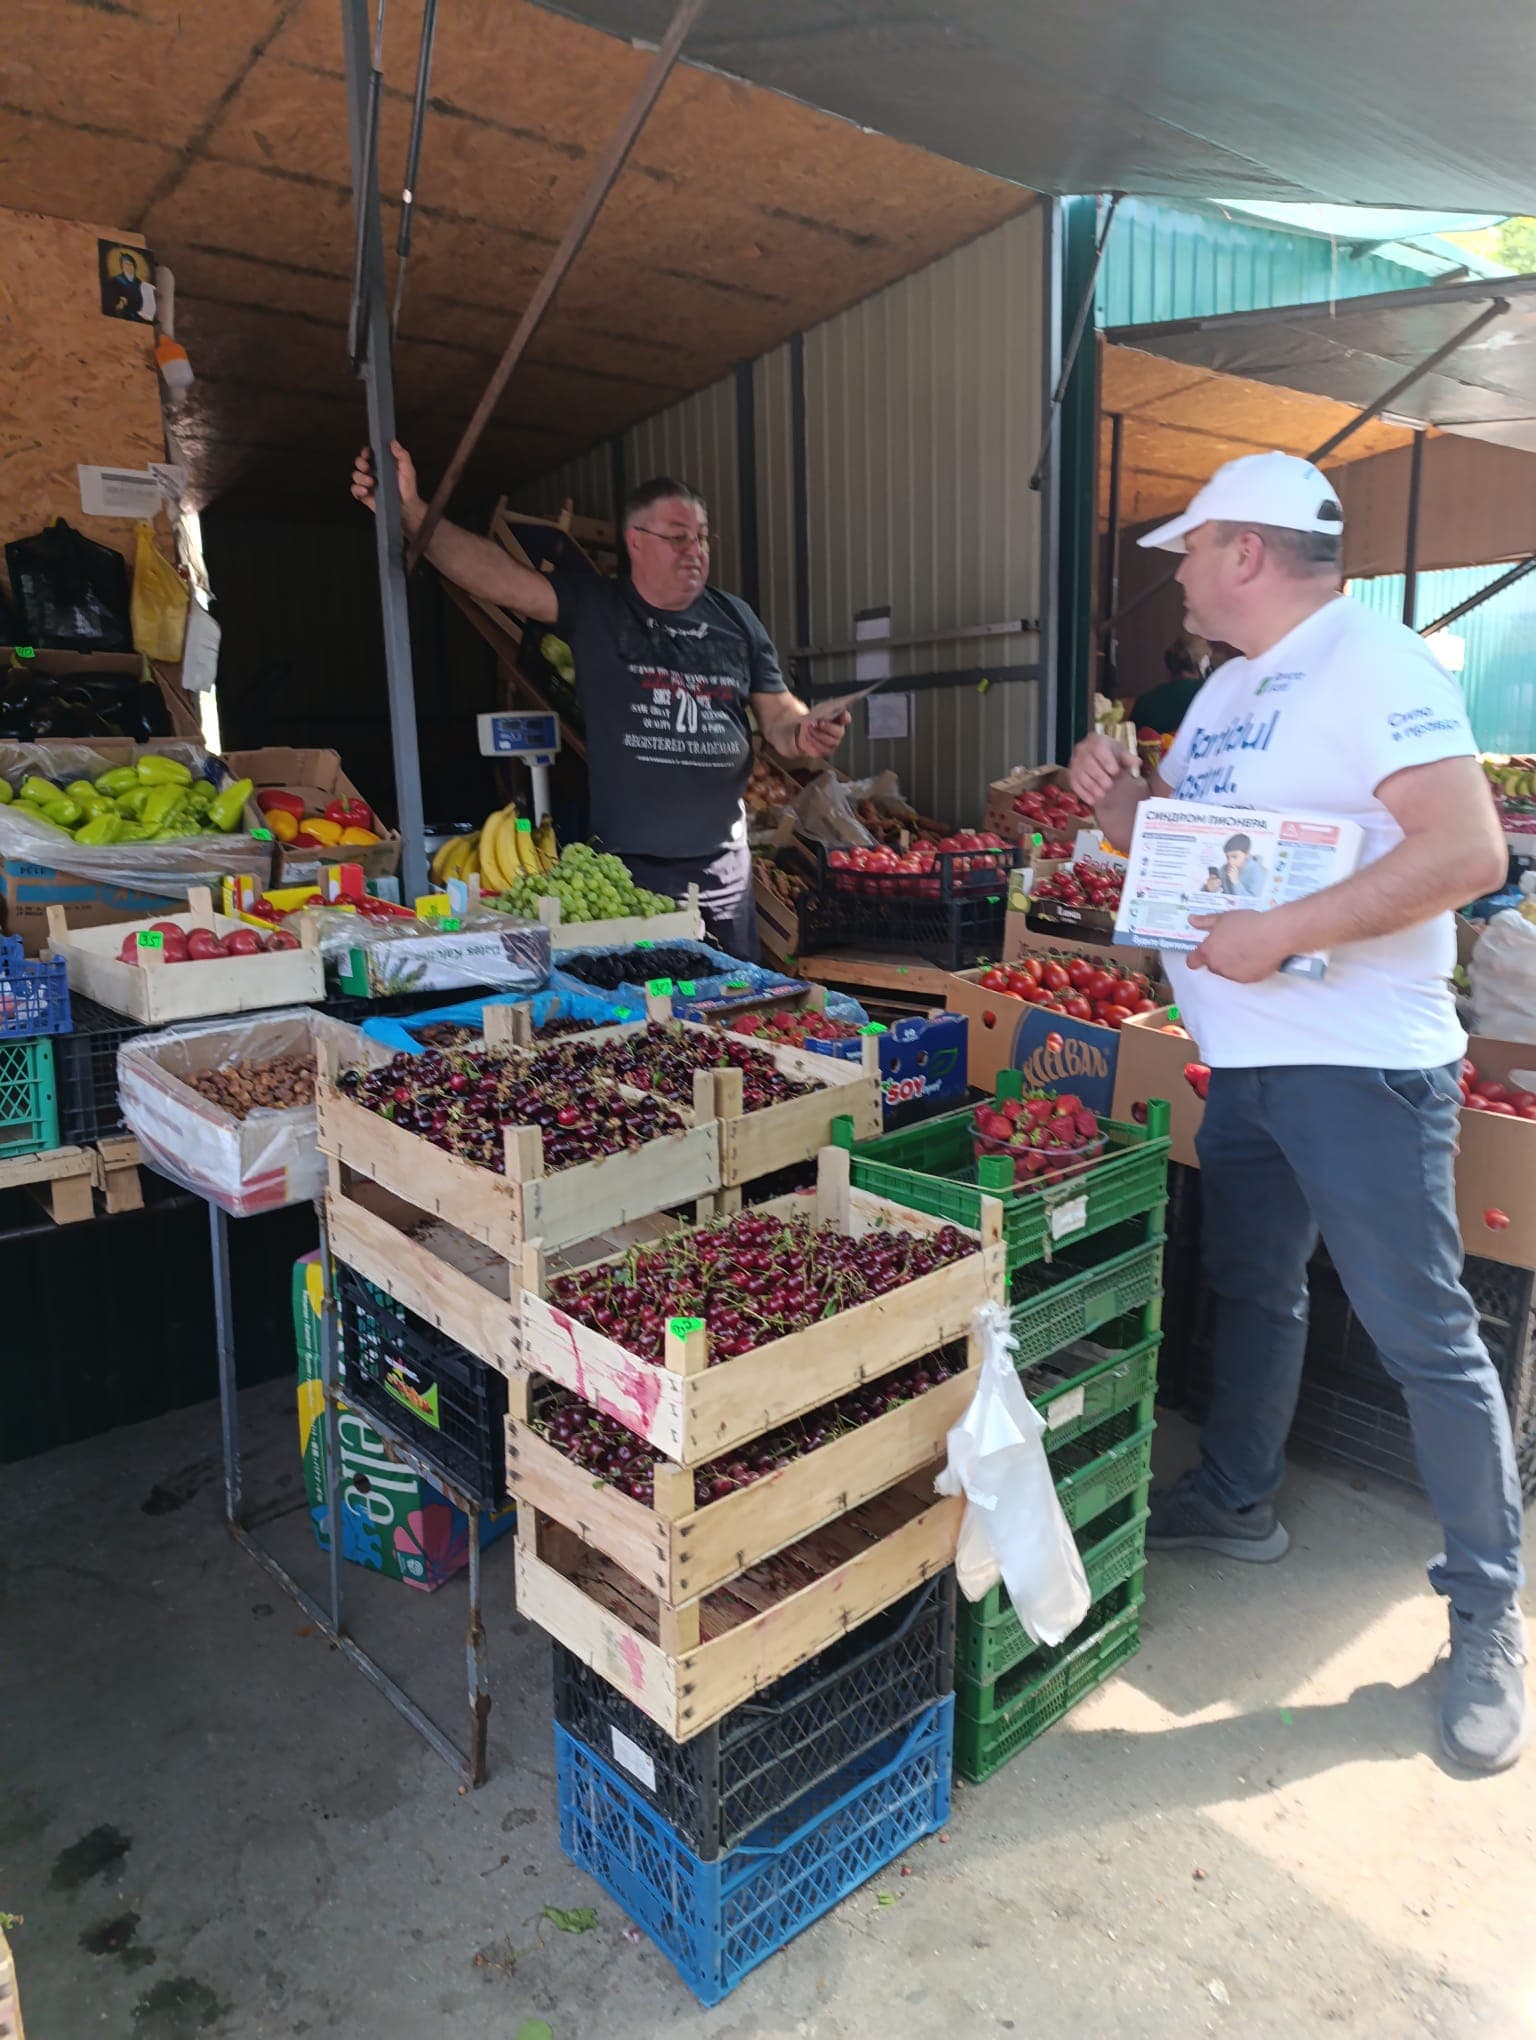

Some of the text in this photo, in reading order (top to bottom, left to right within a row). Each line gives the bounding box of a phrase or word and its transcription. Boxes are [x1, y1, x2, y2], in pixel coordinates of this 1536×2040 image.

[623, 733, 741, 755] REGISTERED TRADEMARK
[886, 1075, 926, 1105] SOY
